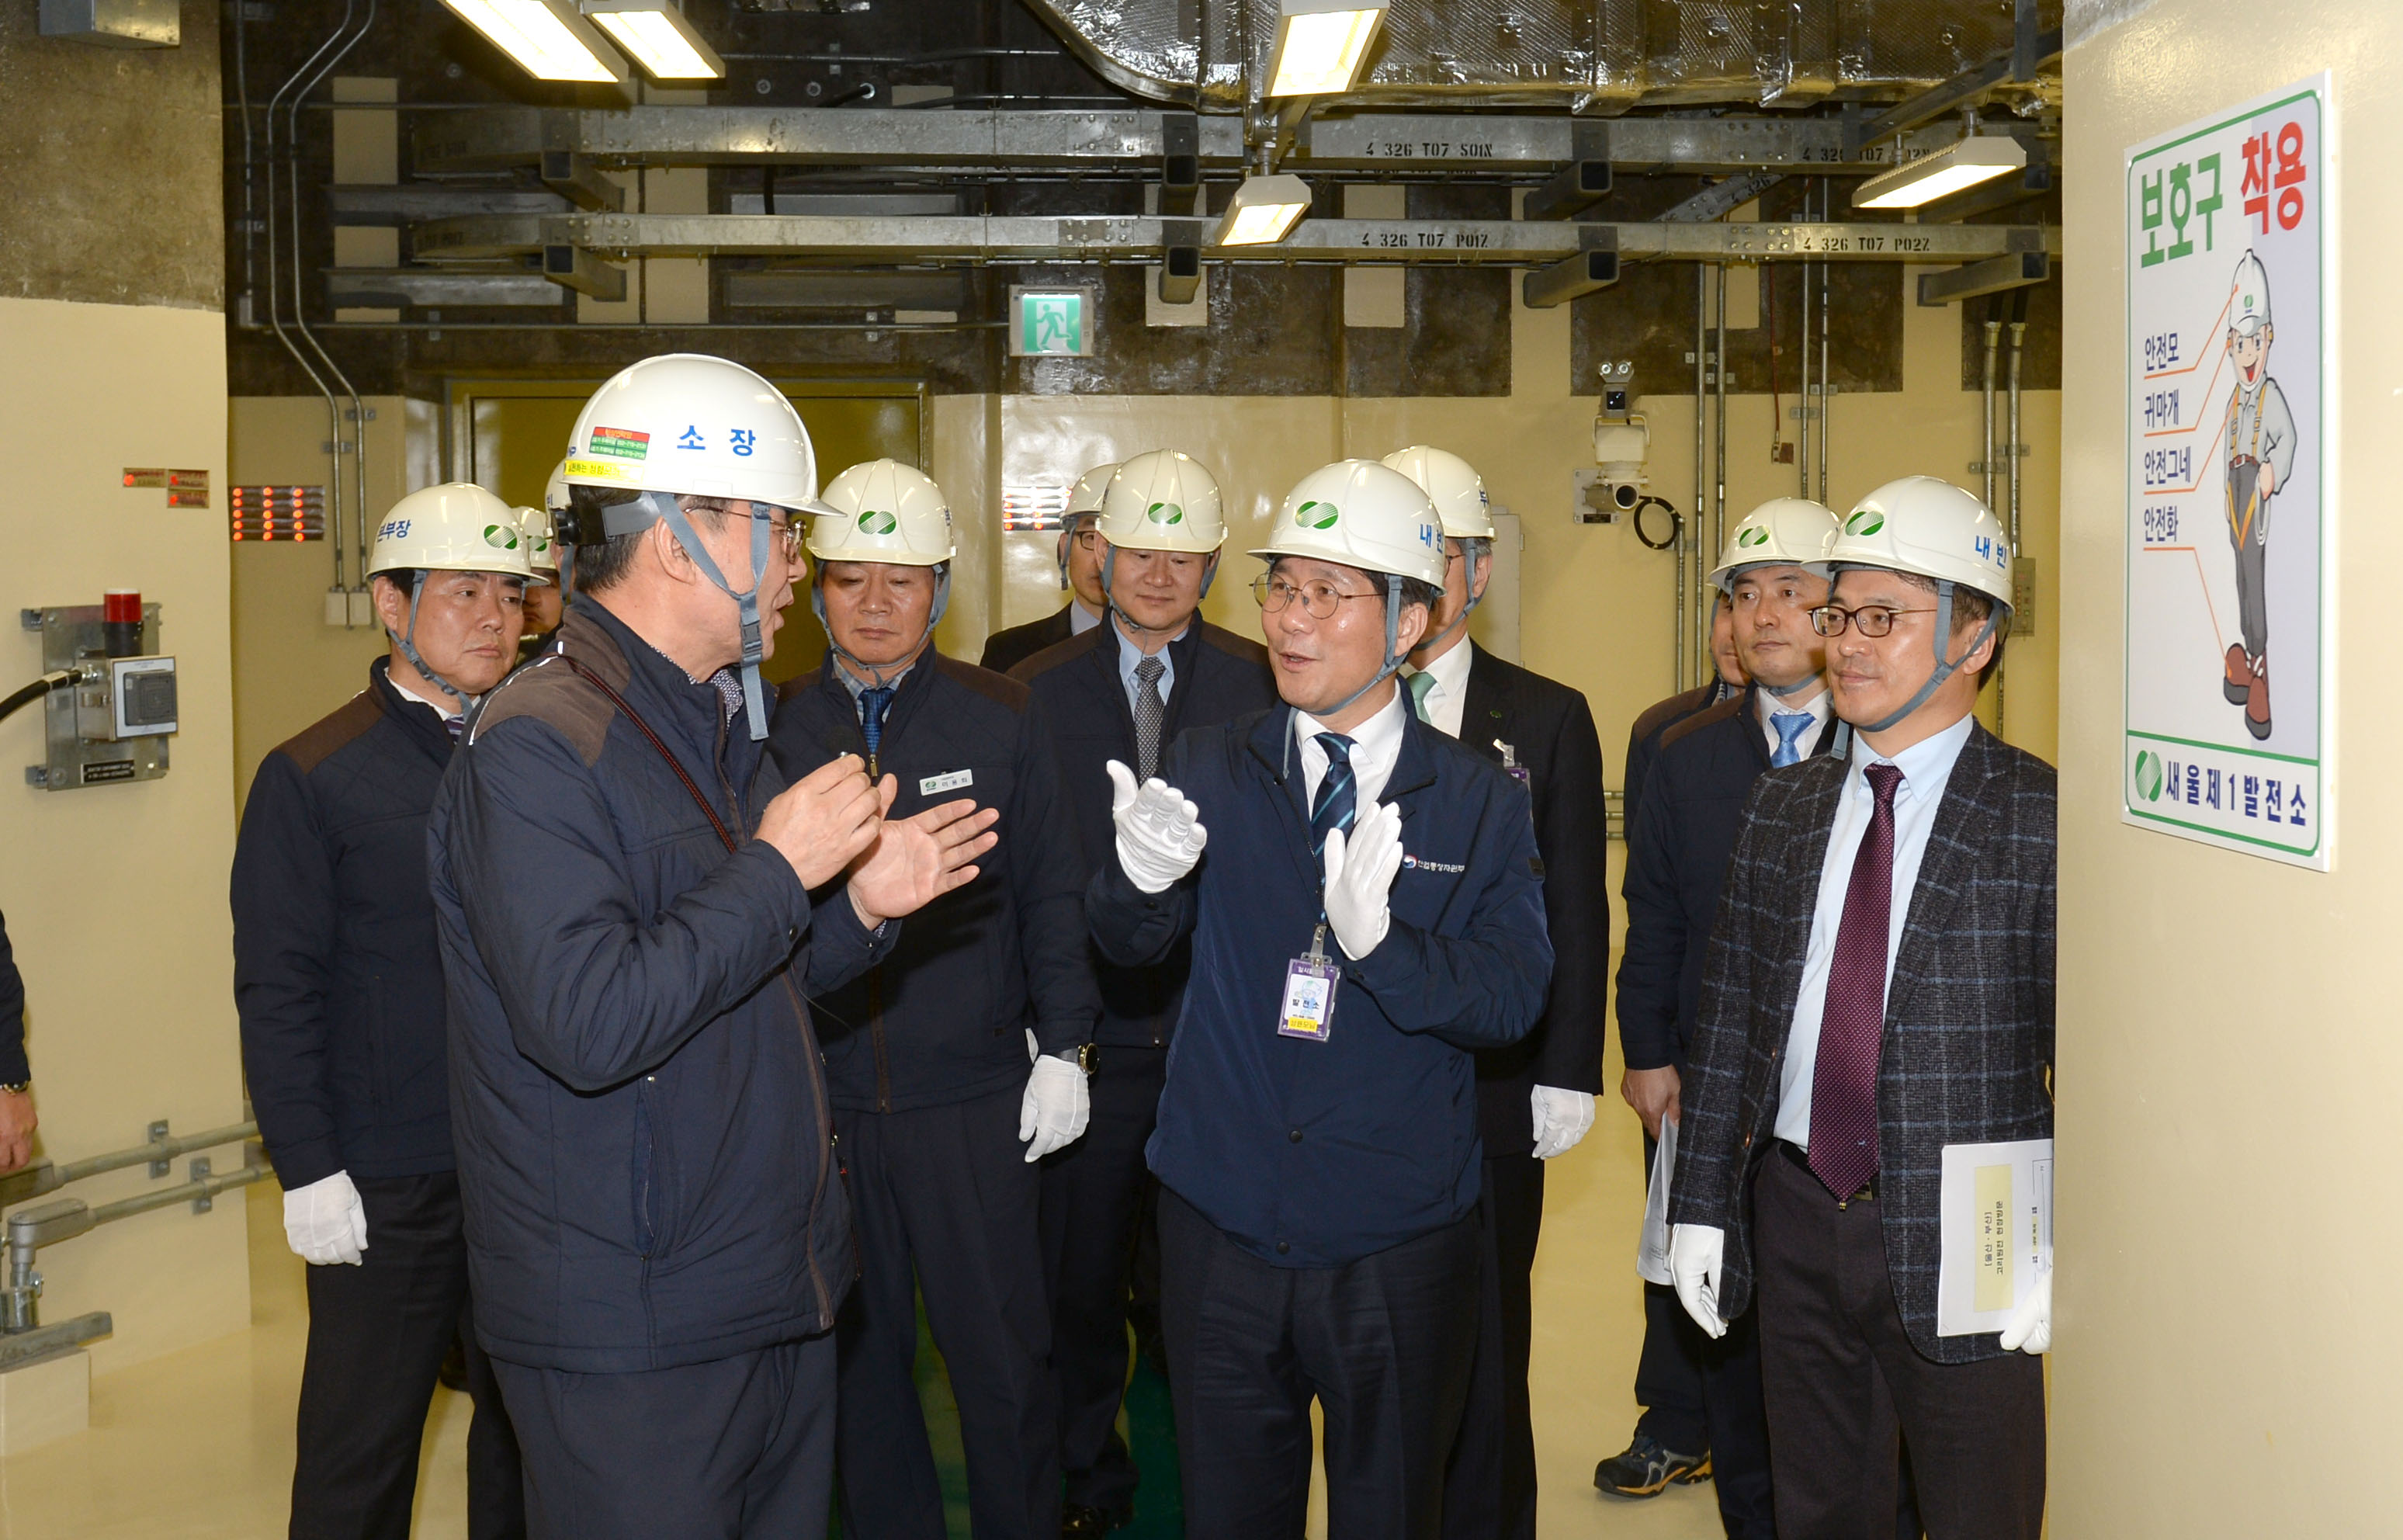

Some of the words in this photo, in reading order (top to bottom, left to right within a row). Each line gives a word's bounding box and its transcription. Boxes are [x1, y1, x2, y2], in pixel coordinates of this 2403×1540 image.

[1366, 142, 1374, 156] 4
[1385, 143, 1413, 157] 326
[1422, 143, 1449, 157] T07
[2141, 152, 2223, 268] 보호구
[2241, 121, 2307, 235] 착용
[1361, 233, 1370, 247] 4
[1380, 234, 1408, 247] 326
[1417, 234, 1444, 247] T07
[1803, 237, 1812, 251] 4
[1821, 238, 1849, 251] 326
[1858, 237, 1885, 251] T07
[2145, 333, 2179, 372] 안전모
[2145, 388, 2179, 428] 귀마개
[2145, 446, 2191, 485] 안전그네
[2144, 505, 2179, 543] 안전화
